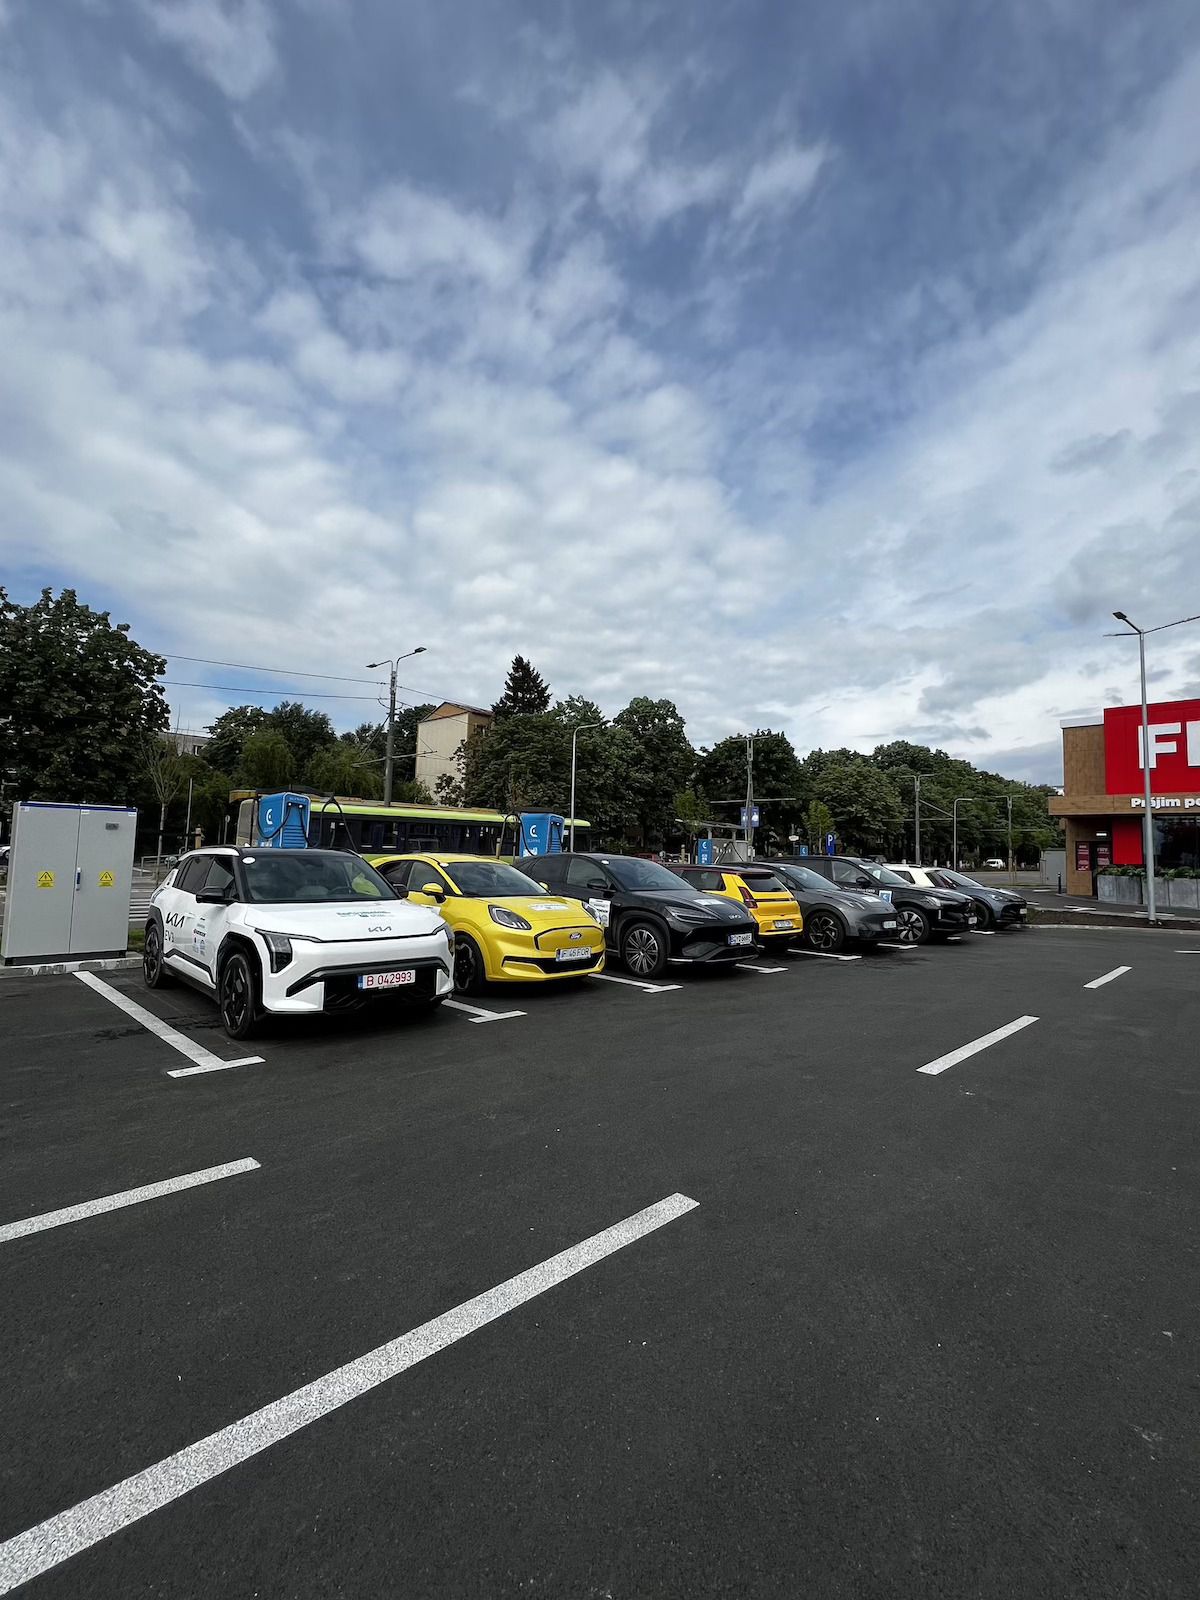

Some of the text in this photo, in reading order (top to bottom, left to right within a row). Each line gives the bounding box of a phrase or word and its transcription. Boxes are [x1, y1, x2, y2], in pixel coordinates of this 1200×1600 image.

[827, 834, 833, 846] P
[366, 971, 412, 986] B 042993
